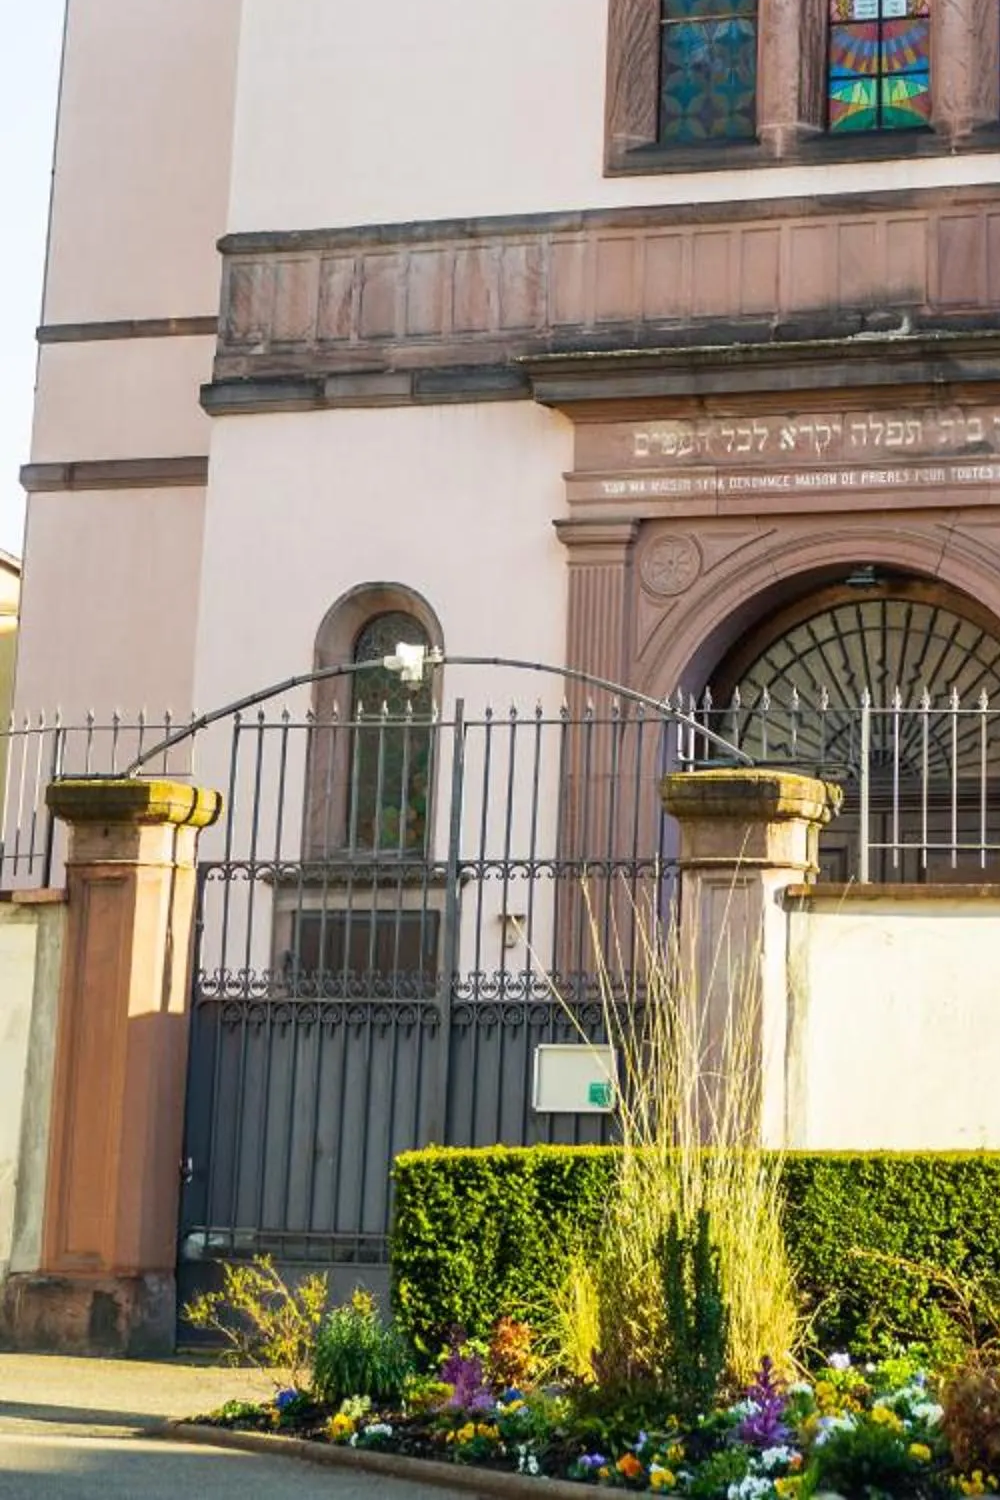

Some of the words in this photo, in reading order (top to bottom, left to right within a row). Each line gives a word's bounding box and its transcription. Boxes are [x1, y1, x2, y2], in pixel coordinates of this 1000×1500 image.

[720, 419, 769, 453] לכל
[779, 423, 842, 459] יקרא
[850, 414, 923, 446] תפלה
[795, 472, 837, 486] MAISON
[841, 471, 854, 485] DE
[950, 465, 993, 480] TOUTES
